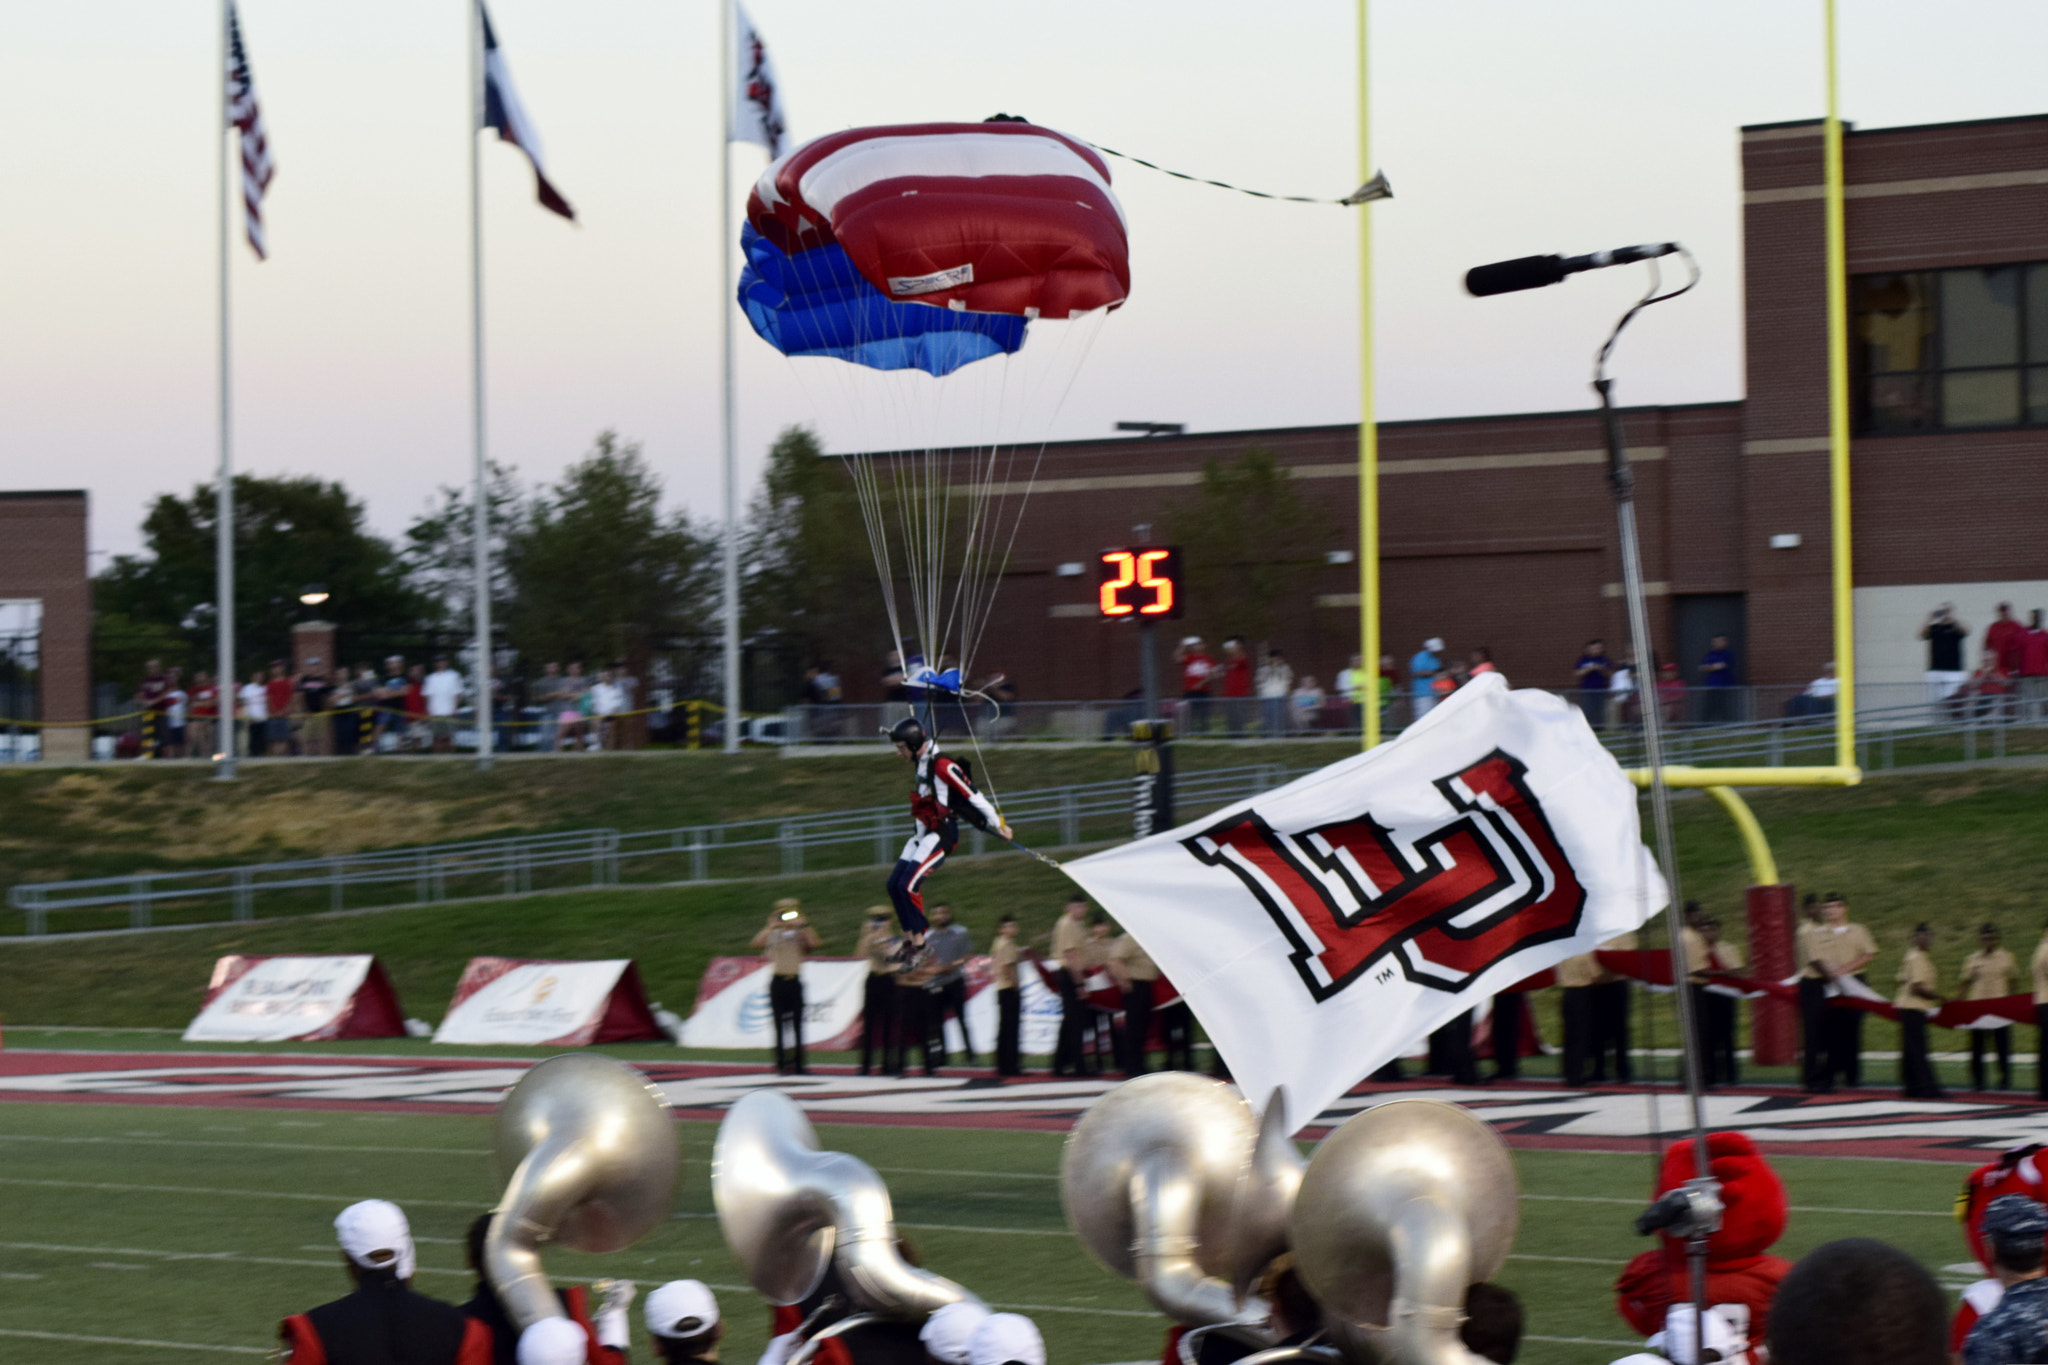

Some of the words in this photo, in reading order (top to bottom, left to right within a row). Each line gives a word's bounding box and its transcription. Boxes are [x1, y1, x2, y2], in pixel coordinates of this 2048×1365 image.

[893, 266, 970, 293] SPECTRE
[1100, 550, 1174, 615] 25
[1374, 967, 1395, 985] TM
